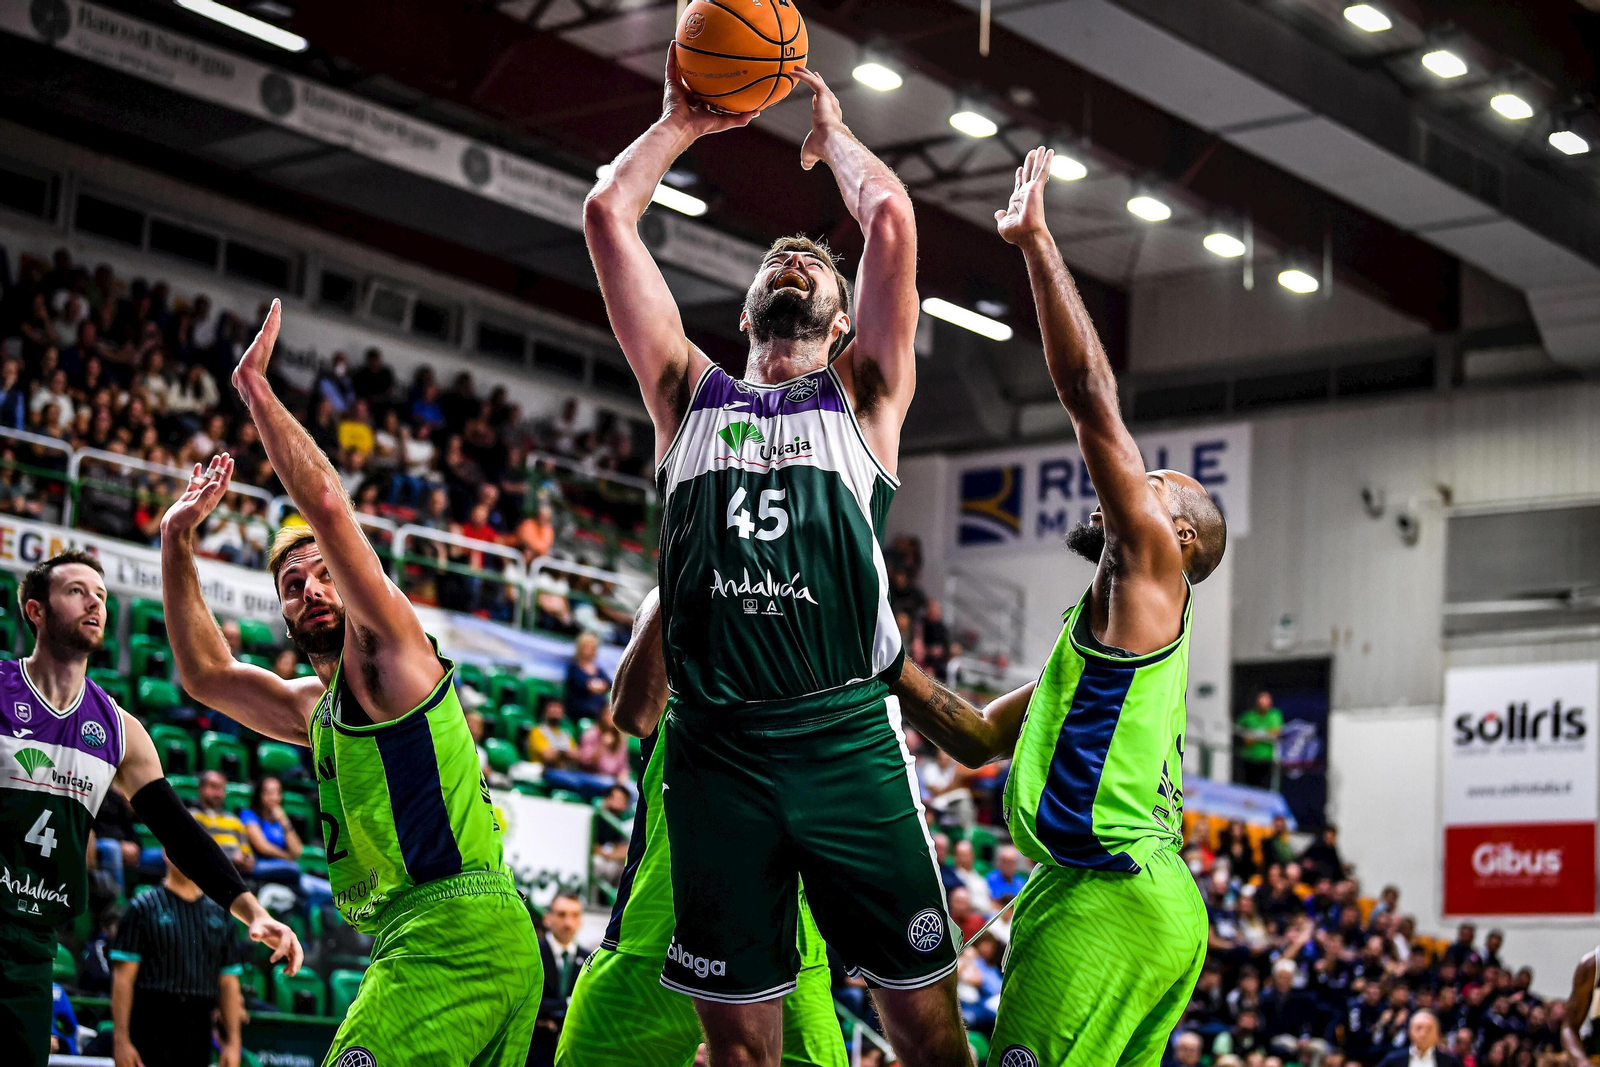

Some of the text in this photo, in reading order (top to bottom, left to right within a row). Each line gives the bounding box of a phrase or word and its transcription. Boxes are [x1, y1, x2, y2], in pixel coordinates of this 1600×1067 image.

[760, 436, 812, 461] Uncaja
[727, 486, 789, 541] 45
[710, 567, 819, 606] Andalucía
[1454, 698, 1587, 746] soliris
[52, 770, 93, 792] Unicaja
[25, 809, 57, 858] 4
[1471, 842, 1563, 876] Gibus
[667, 935, 726, 978] álaga
